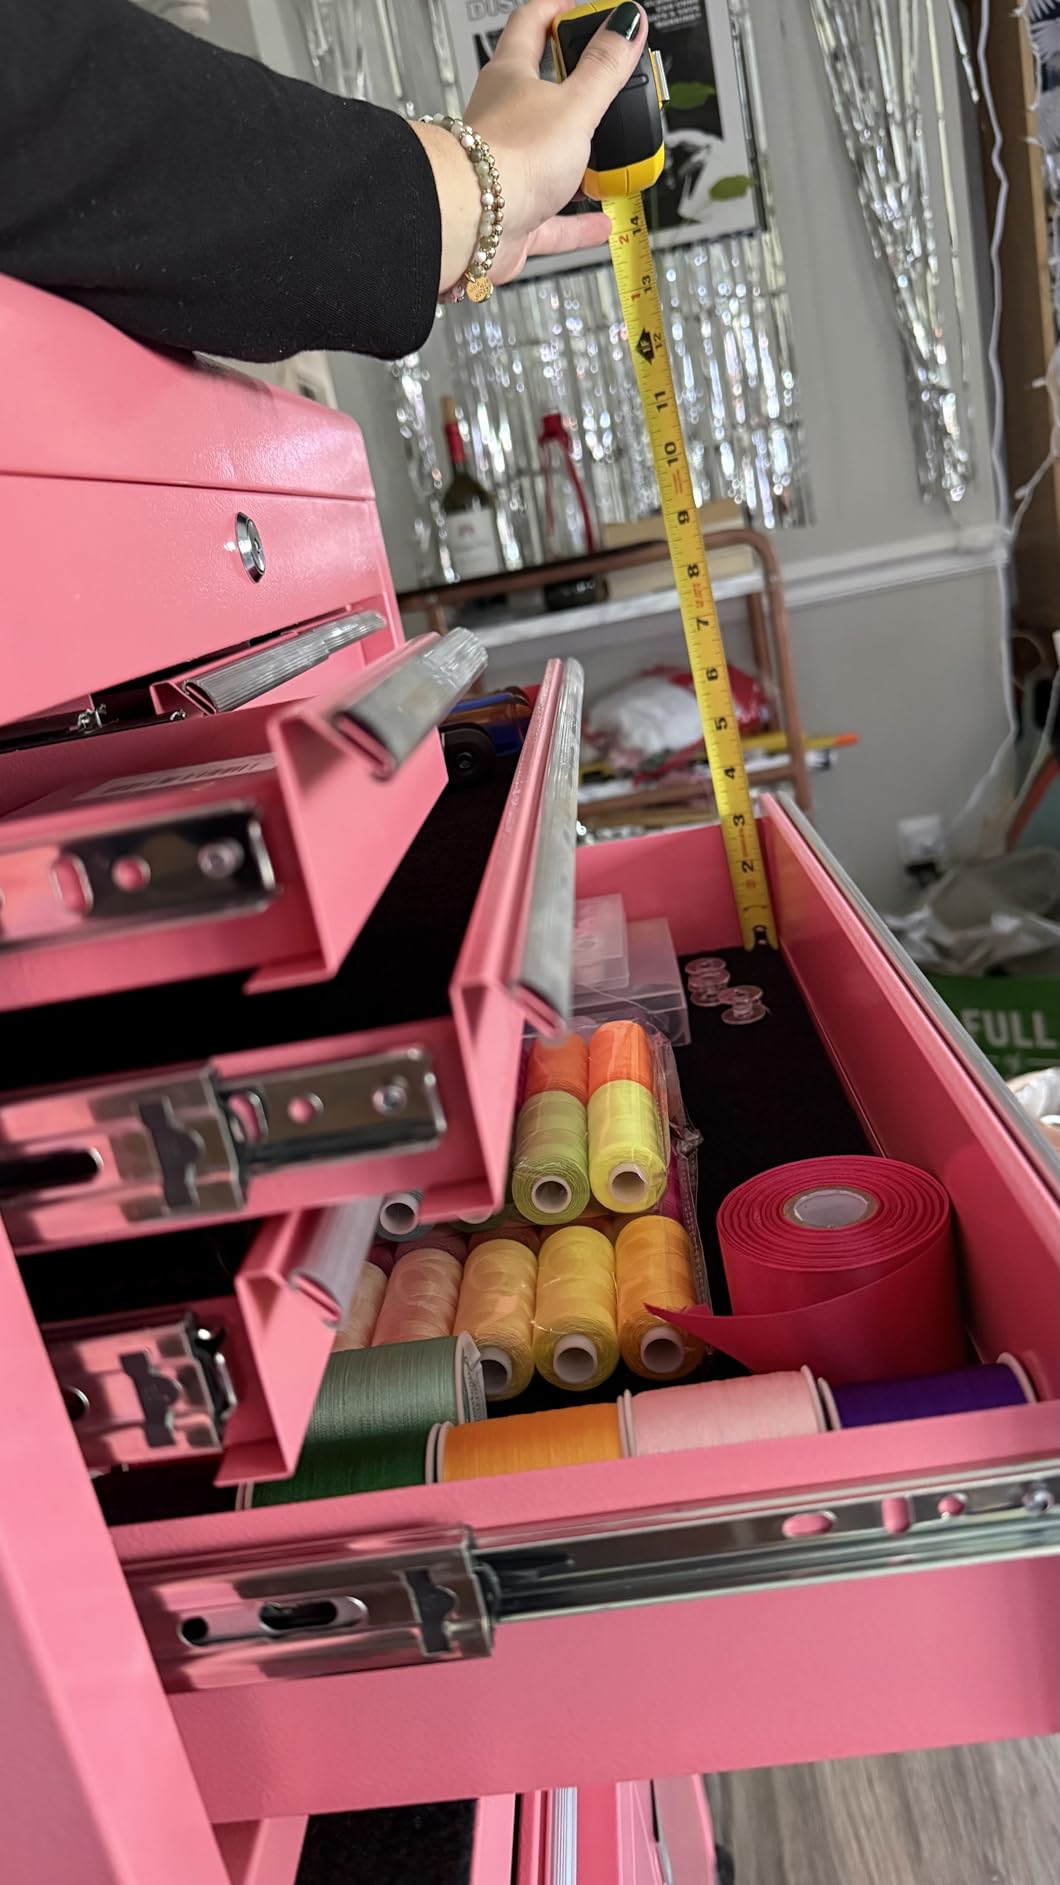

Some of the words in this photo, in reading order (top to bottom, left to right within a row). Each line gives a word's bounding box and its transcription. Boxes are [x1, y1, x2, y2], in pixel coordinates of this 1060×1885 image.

[630, 216, 642, 236] 14
[619, 233, 630, 245] 2
[642, 274, 653, 295] 13
[653, 332, 663, 349] 12
[654, 391, 668, 411] 11
[664, 441, 679, 466] 10
[677, 511, 690, 525] 9
[687, 563, 700, 578] 8
[696, 617, 710, 631] 7
[706, 668, 719, 682] 6
[715, 717, 728, 731] 5
[724, 767, 736, 780] 4
[733, 814, 746, 827] 3
[742, 860, 754, 873] 2
[961, 1008, 1057, 1049] FULL
